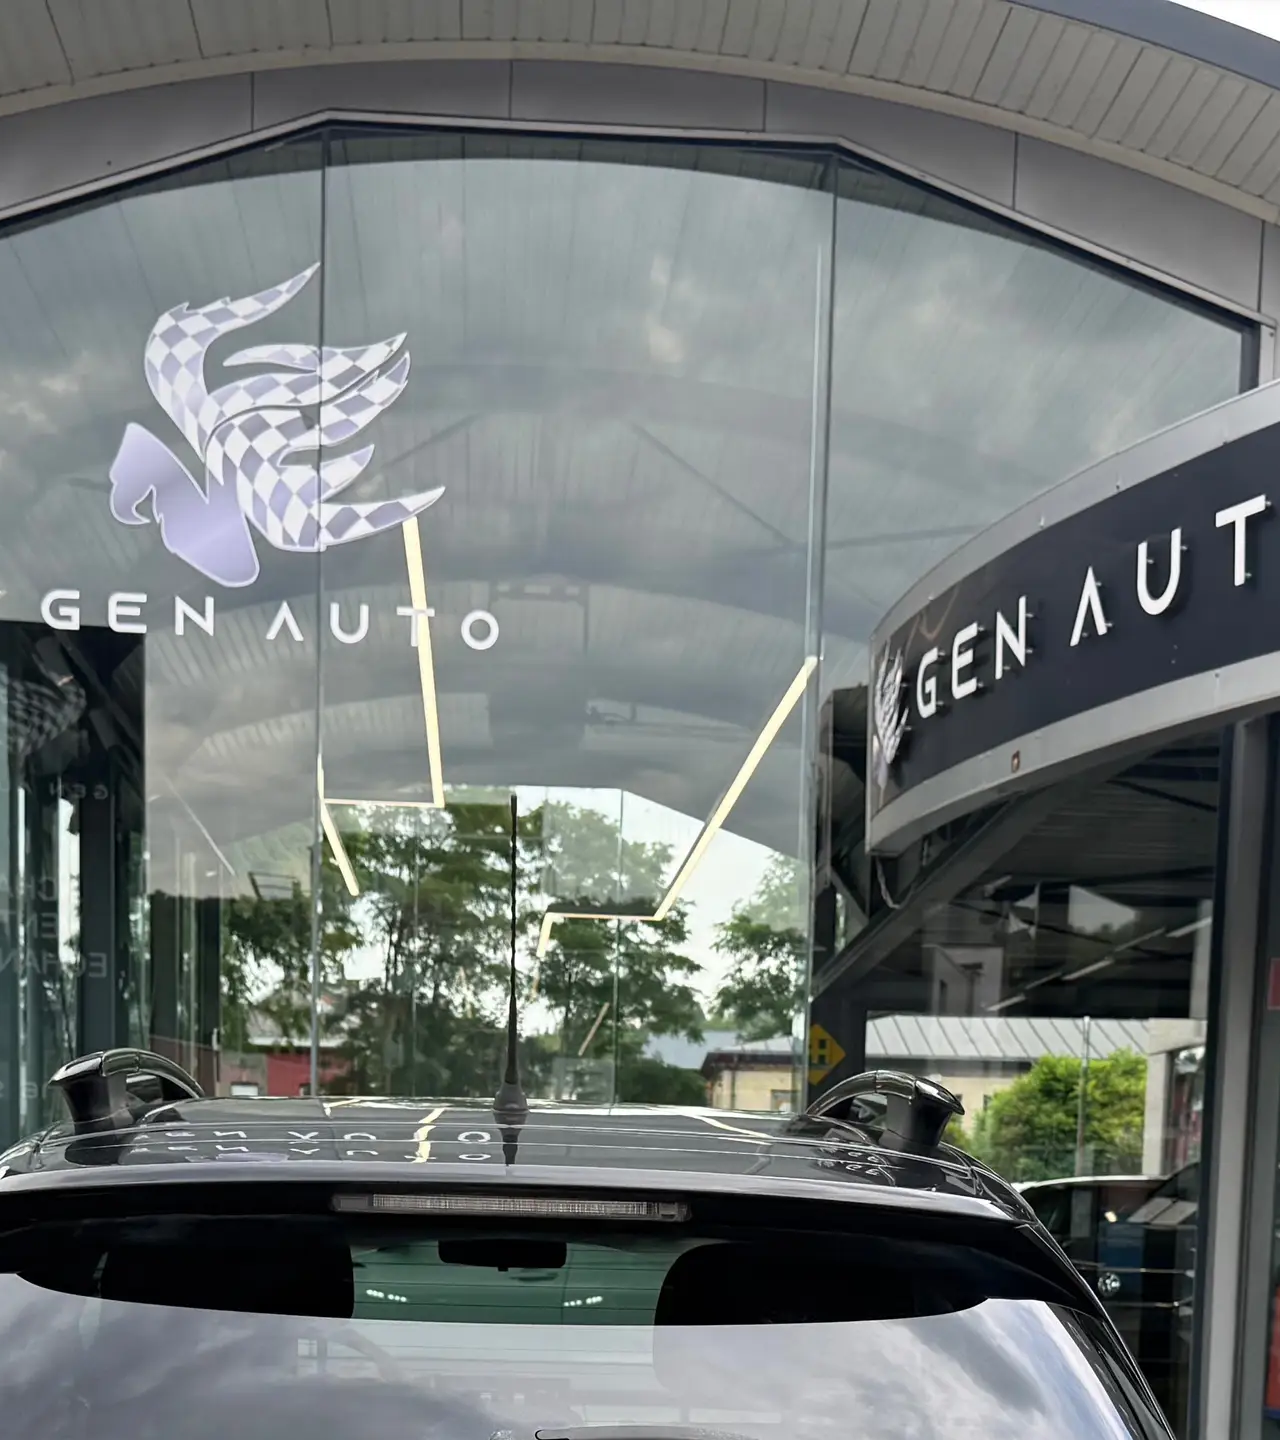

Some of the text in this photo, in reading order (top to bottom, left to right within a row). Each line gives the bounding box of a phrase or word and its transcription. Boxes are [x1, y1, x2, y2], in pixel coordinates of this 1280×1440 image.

[40, 590, 500, 651] GEN AUTO
[916, 595, 1029, 719] GEN
